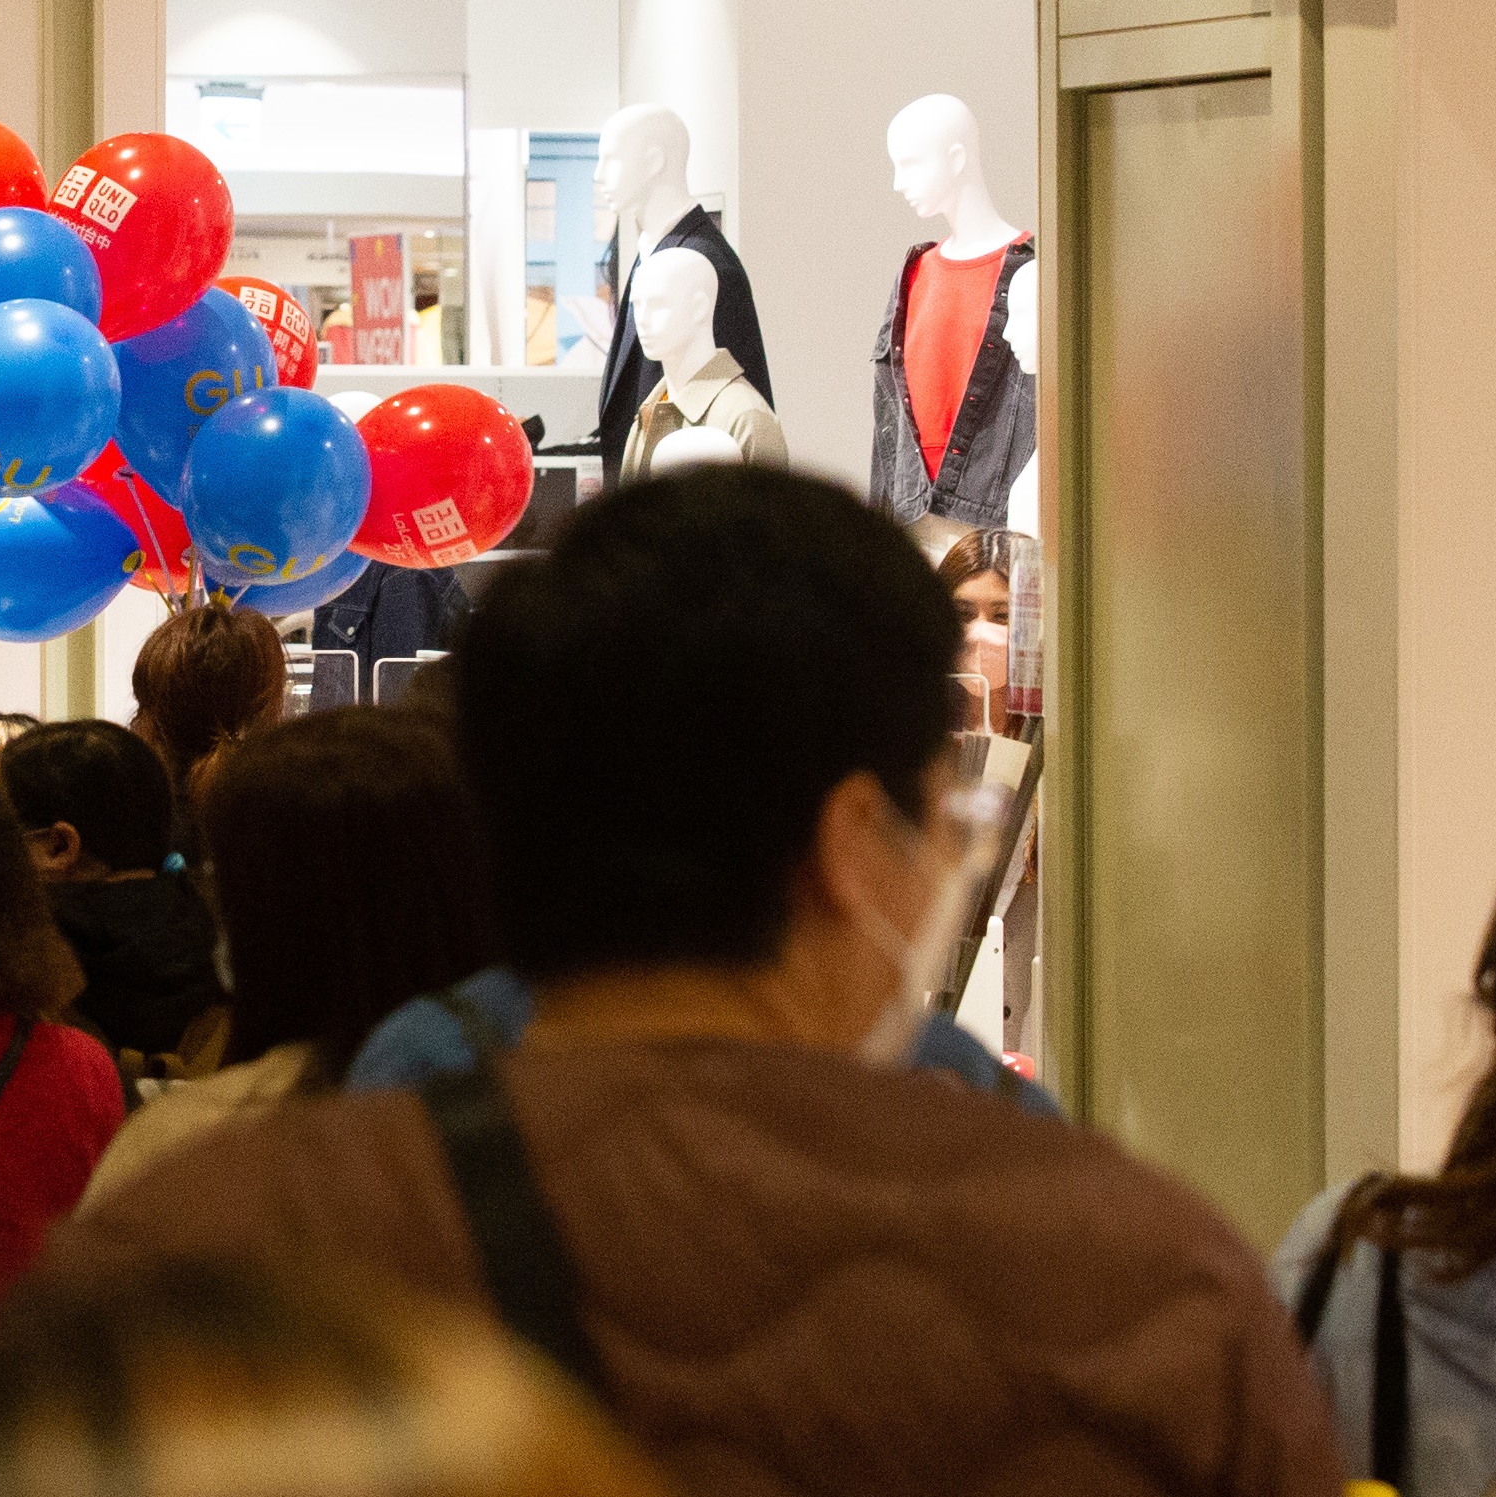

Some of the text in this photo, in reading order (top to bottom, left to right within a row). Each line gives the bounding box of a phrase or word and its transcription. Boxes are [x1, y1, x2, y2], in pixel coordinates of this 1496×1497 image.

[98, 182, 128, 208] UNI
[88, 198, 119, 224] QLO
[284, 315, 307, 338] QLO
[184, 365, 264, 417] GU
[227, 543, 326, 581] GU
